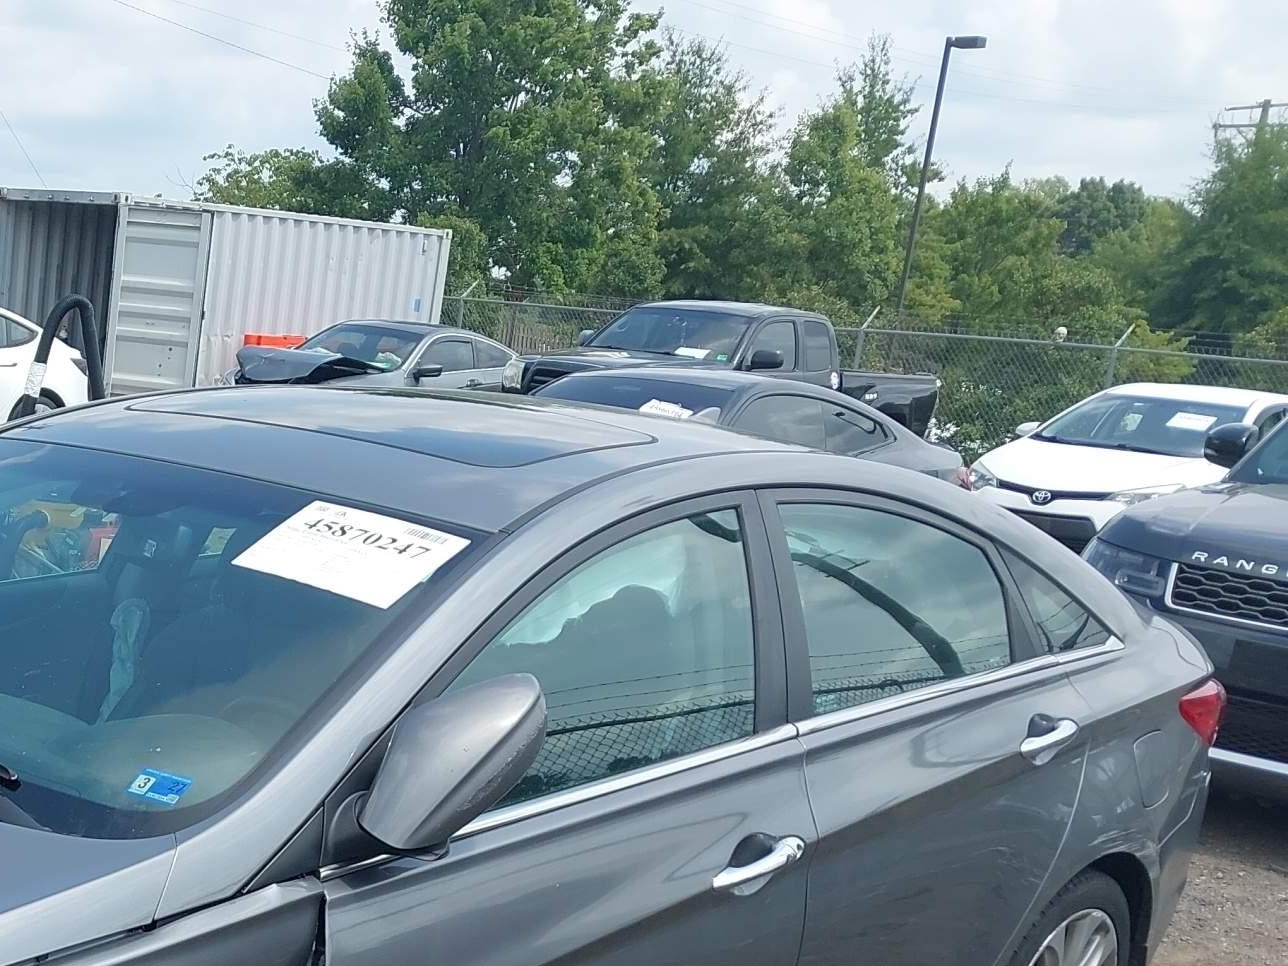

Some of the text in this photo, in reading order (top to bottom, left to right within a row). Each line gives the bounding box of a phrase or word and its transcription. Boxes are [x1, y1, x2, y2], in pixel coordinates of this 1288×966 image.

[304, 518, 431, 558] 45870247
[1191, 551, 1288, 577] RANG
[137, 777, 151, 789] 3
